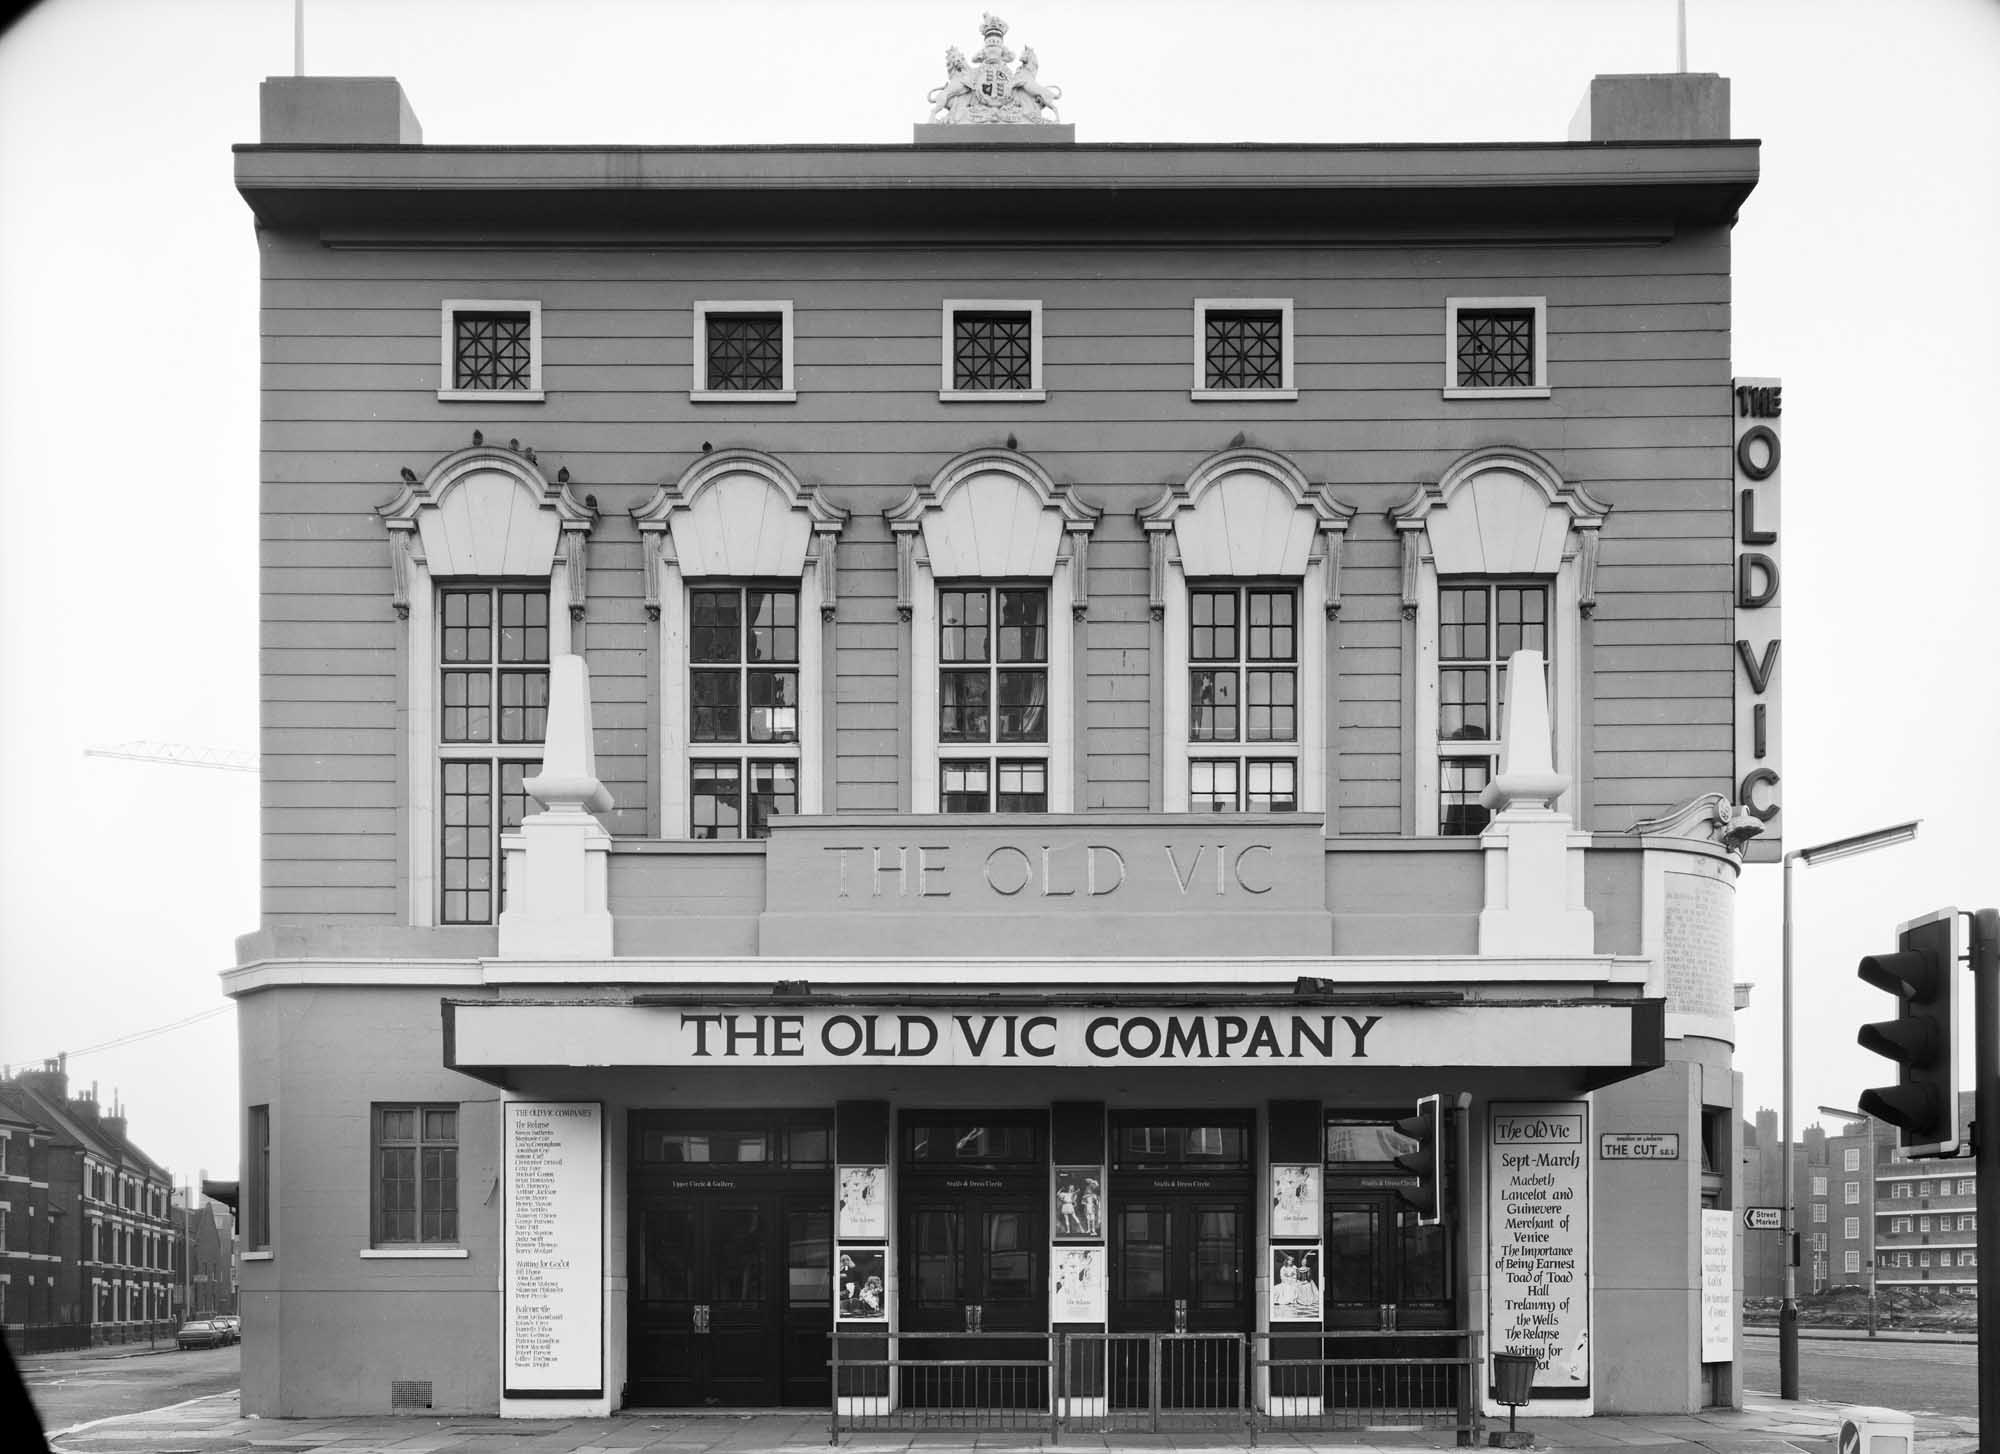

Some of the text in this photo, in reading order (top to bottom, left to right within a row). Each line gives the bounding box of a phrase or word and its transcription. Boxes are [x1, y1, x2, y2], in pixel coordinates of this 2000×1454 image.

[1736, 385, 1782, 823] THE OLD VIC
[824, 845, 1273, 897] THE OLD VIC
[681, 1013, 1383, 1058] THE OLD VIC COMPANY
[1498, 1120, 1570, 1140] The Old Vic
[1605, 1144, 1628, 1155] THE
[1633, 1144, 1657, 1155] CUT
[1510, 1173, 1555, 1187] Macbeth
[1501, 1187, 1574, 1201] Lancelot and
[1507, 1203, 1562, 1215] Guinevere
[1756, 1210, 1777, 1218] Street
[1505, 1214, 1570, 1232] Merchant of
[1756, 1218, 1779, 1226] Market
[1514, 1232, 1550, 1243] Venice
[1501, 1244, 1573, 1259] The Importance
[1495, 1257, 1575, 1272] of Being Earnest
[1506, 1270, 1573, 1286] Toad of Toad
[1528, 1284, 1549, 1296] Hall
[1505, 1296, 1570, 1314] Trelawny of
[1516, 1313, 1559, 1326] the Wells
[1504, 1326, 1560, 1344] The Relapse
[1549, 1343, 1563, 1360] for
